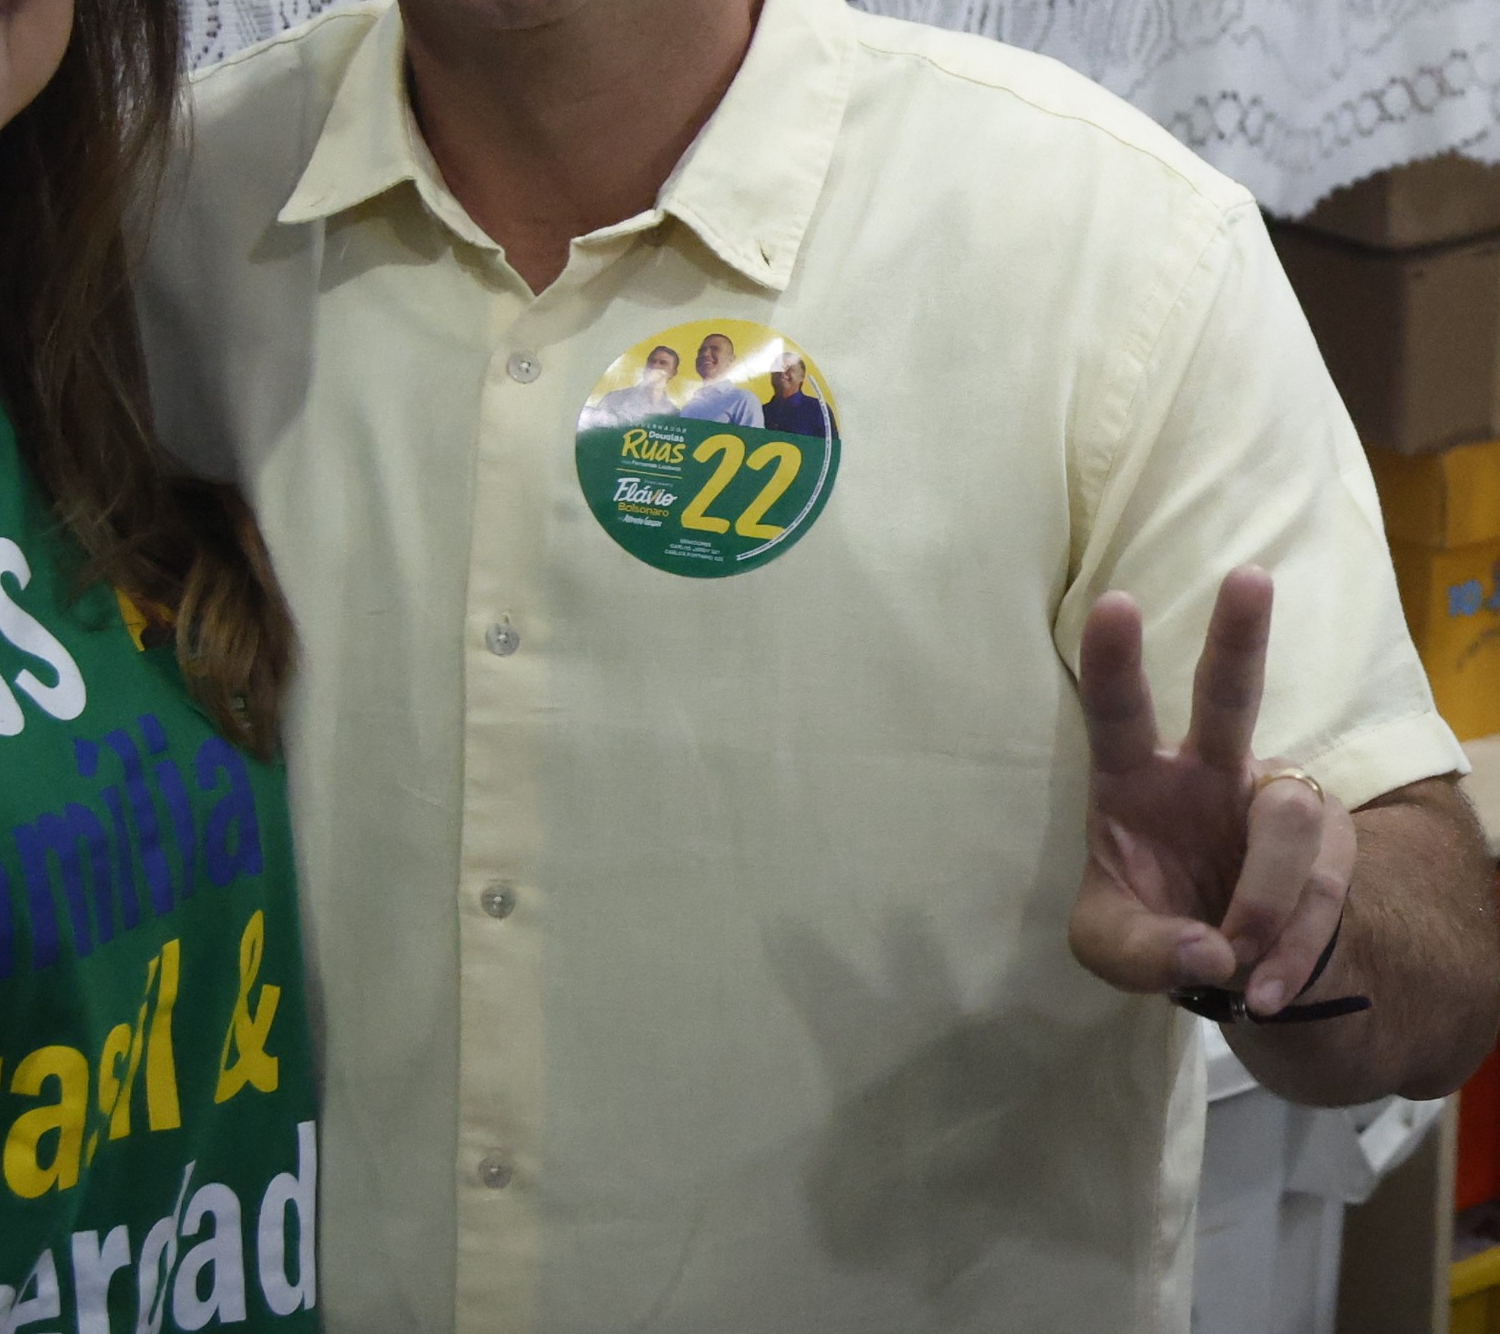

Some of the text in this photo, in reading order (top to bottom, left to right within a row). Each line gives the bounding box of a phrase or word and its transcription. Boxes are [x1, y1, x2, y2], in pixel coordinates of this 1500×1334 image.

[620, 428, 687, 465] Ruas
[648, 430, 685, 443] Douglas
[612, 477, 678, 507] Flávio
[679, 433, 802, 541] 22
[617, 502, 670, 518] Bolsonaro
[213, 909, 282, 1105] &
